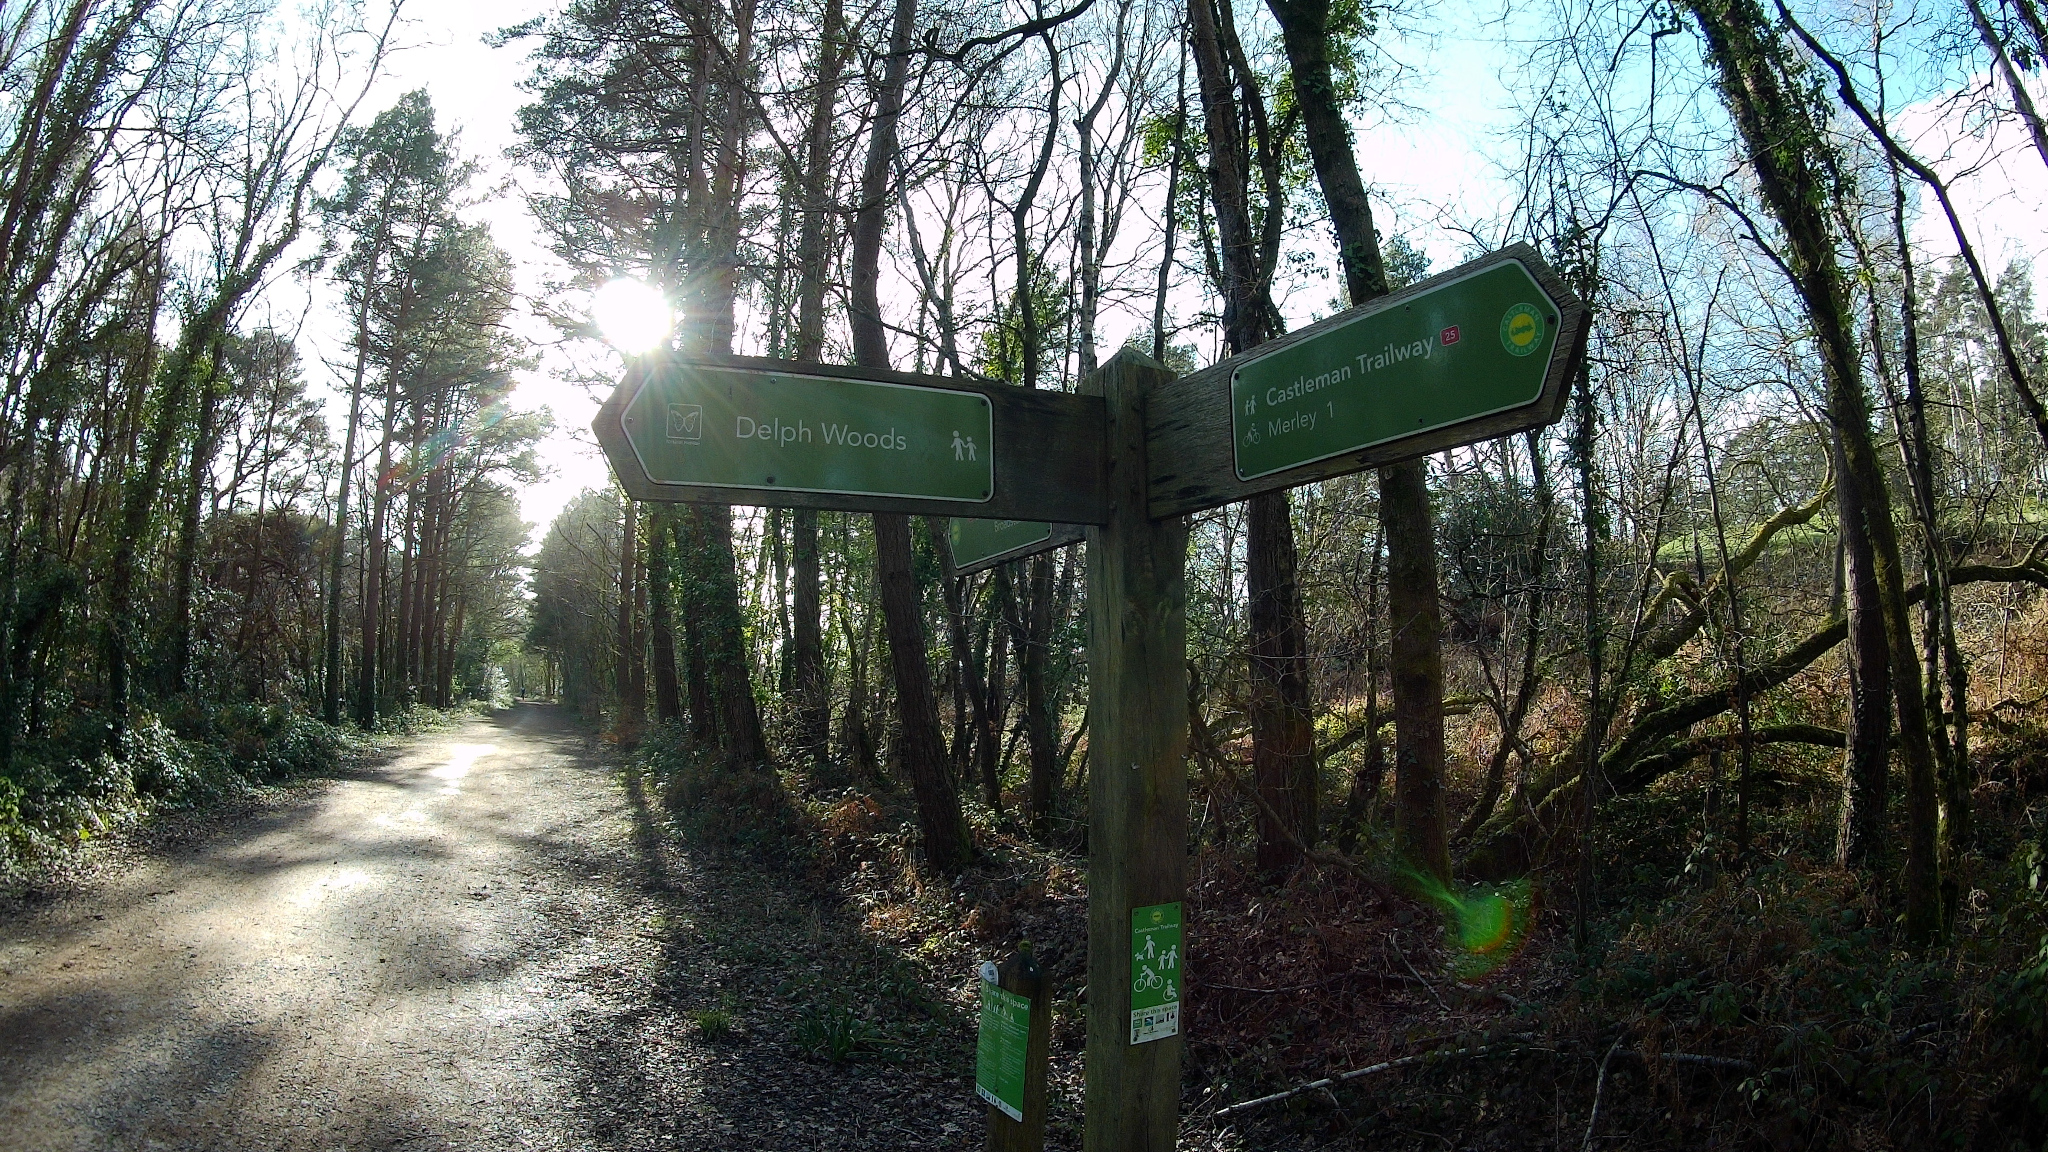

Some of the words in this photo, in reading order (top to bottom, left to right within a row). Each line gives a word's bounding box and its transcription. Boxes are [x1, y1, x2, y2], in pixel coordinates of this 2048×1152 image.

[1266, 365, 1351, 406] Castleman
[1355, 336, 1434, 375] Trailway
[1445, 330, 1456, 341] 25
[736, 415, 812, 448] Delph
[821, 422, 907, 451] Woods
[1268, 411, 1317, 437] Merley
[1326, 400, 1334, 418] 1
